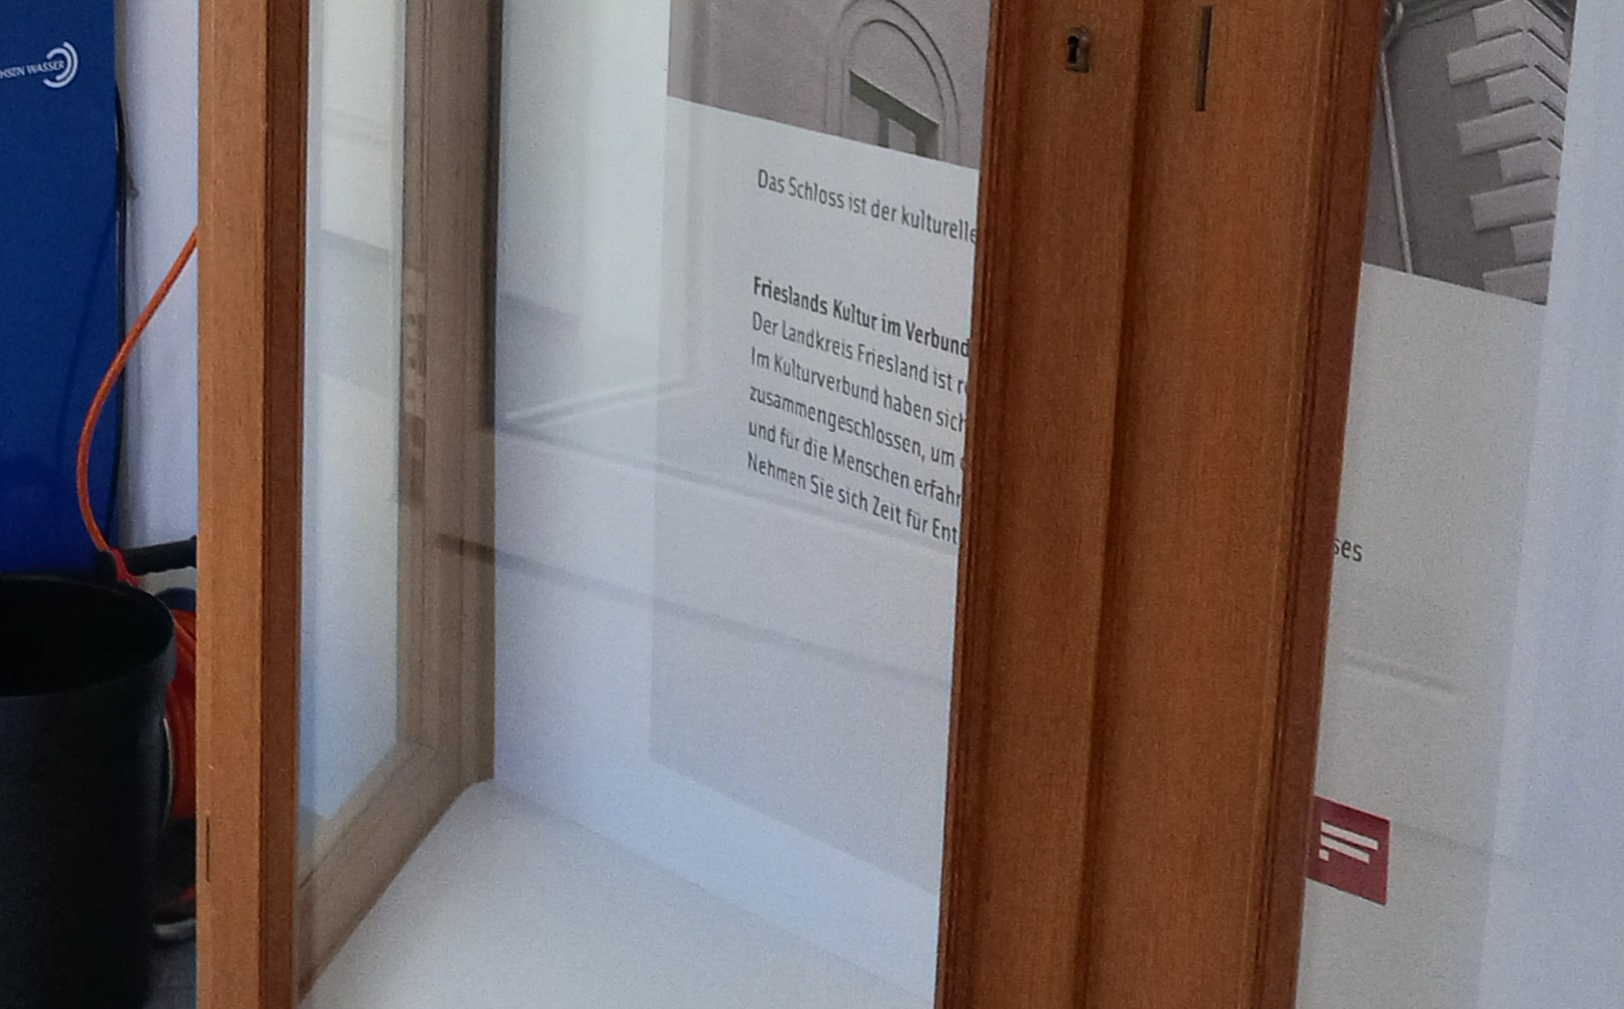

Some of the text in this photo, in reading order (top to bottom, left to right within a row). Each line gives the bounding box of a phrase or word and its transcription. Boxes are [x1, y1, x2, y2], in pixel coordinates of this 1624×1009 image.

[26, 60, 65, 75] WASSER
[758, 168, 977, 244] Das Schloss ist der kulturelle
[753, 311, 779, 336] Der
[782, 319, 853, 360] Landkreis
[858, 343, 928, 384] Friesland
[933, 368, 952, 392] ist
[754, 275, 970, 358] Frieslands Kultur im Verbund
[751, 346, 770, 370] Im
[774, 353, 878, 405] Kulturverbund
[884, 388, 932, 422] haben
[749, 385, 955, 468] zusammengeschlossen, um
[749, 421, 776, 443] und
[804, 437, 828, 461] die
[833, 444, 910, 489] Menschen
[748, 451, 958, 544] Nehmen Sie sich Zeit für Ent
